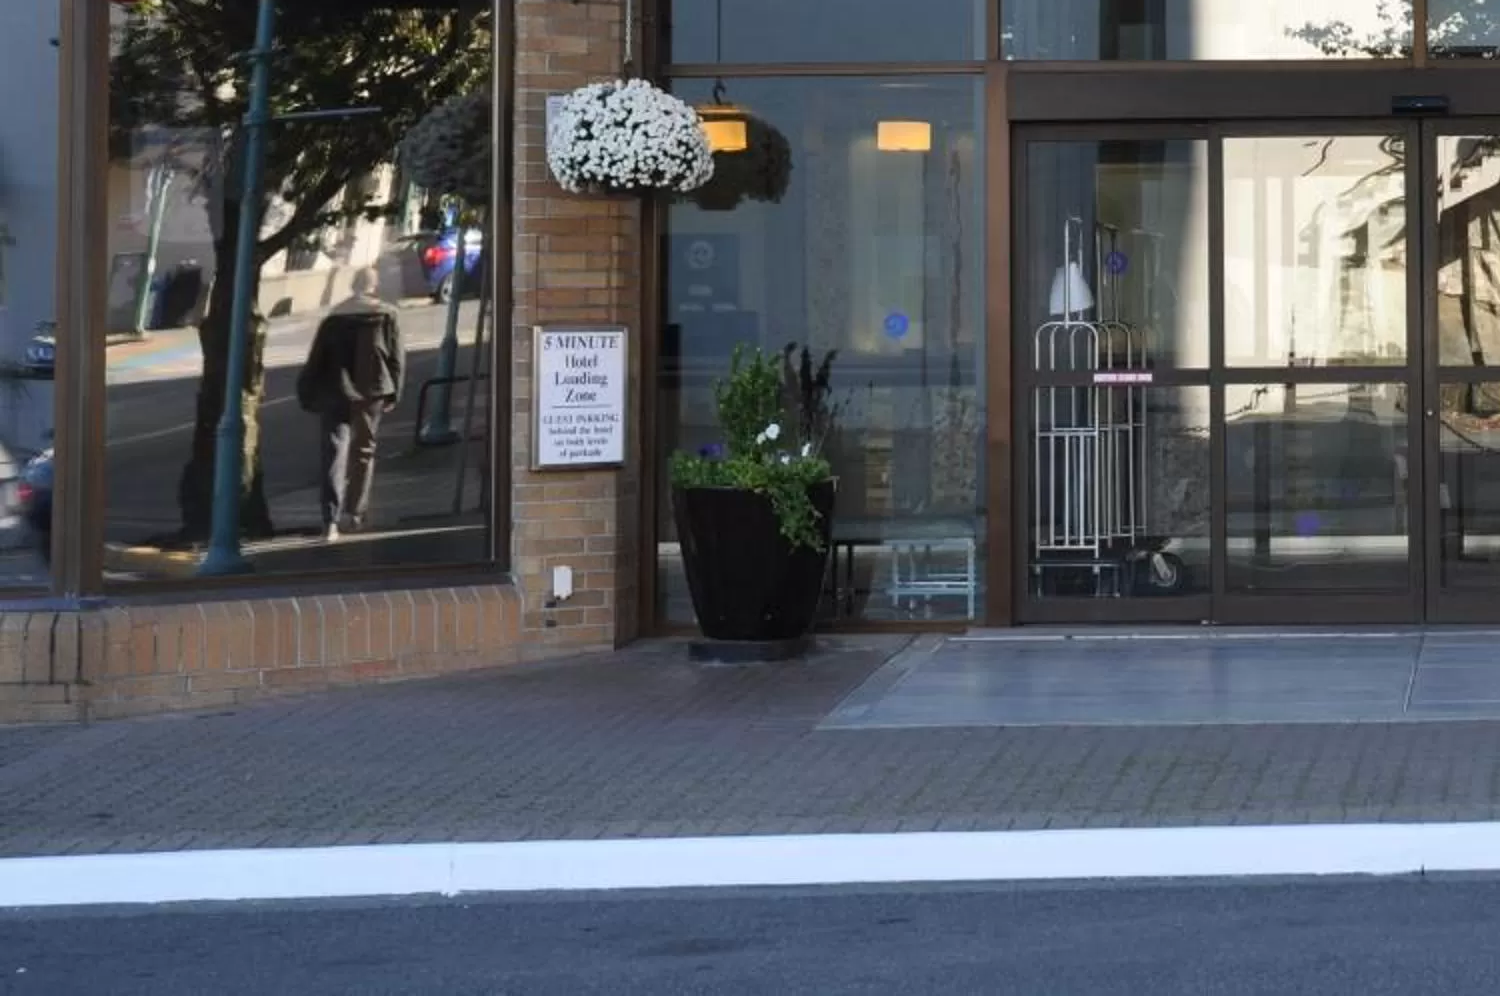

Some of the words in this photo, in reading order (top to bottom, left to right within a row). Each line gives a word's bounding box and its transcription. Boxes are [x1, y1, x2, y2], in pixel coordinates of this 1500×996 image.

[555, 335, 619, 350] MINUTE
[564, 354, 599, 369] Hotel
[564, 389, 598, 403] Zone
